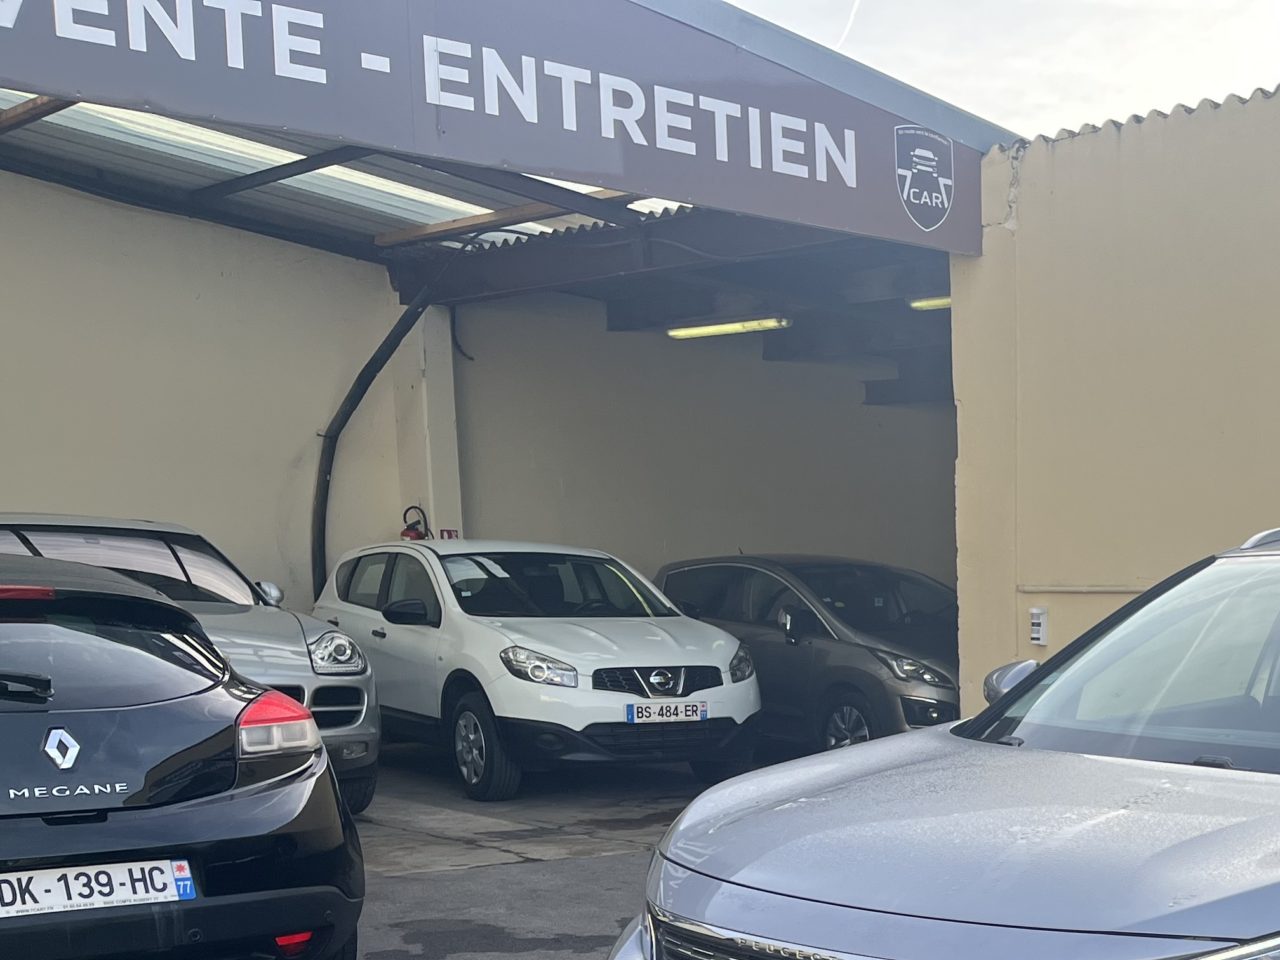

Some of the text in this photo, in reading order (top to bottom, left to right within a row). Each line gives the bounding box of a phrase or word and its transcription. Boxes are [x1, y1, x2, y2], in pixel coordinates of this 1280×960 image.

[0, 0, 327, 84] ENTE
[422, 35, 858, 188] ENTRETIEN
[636, 704, 698, 719] BS-484-ER
[9, 783, 129, 799] MEGANE
[0, 866, 168, 907] DK-139-HC
[177, 881, 191, 894] 77
